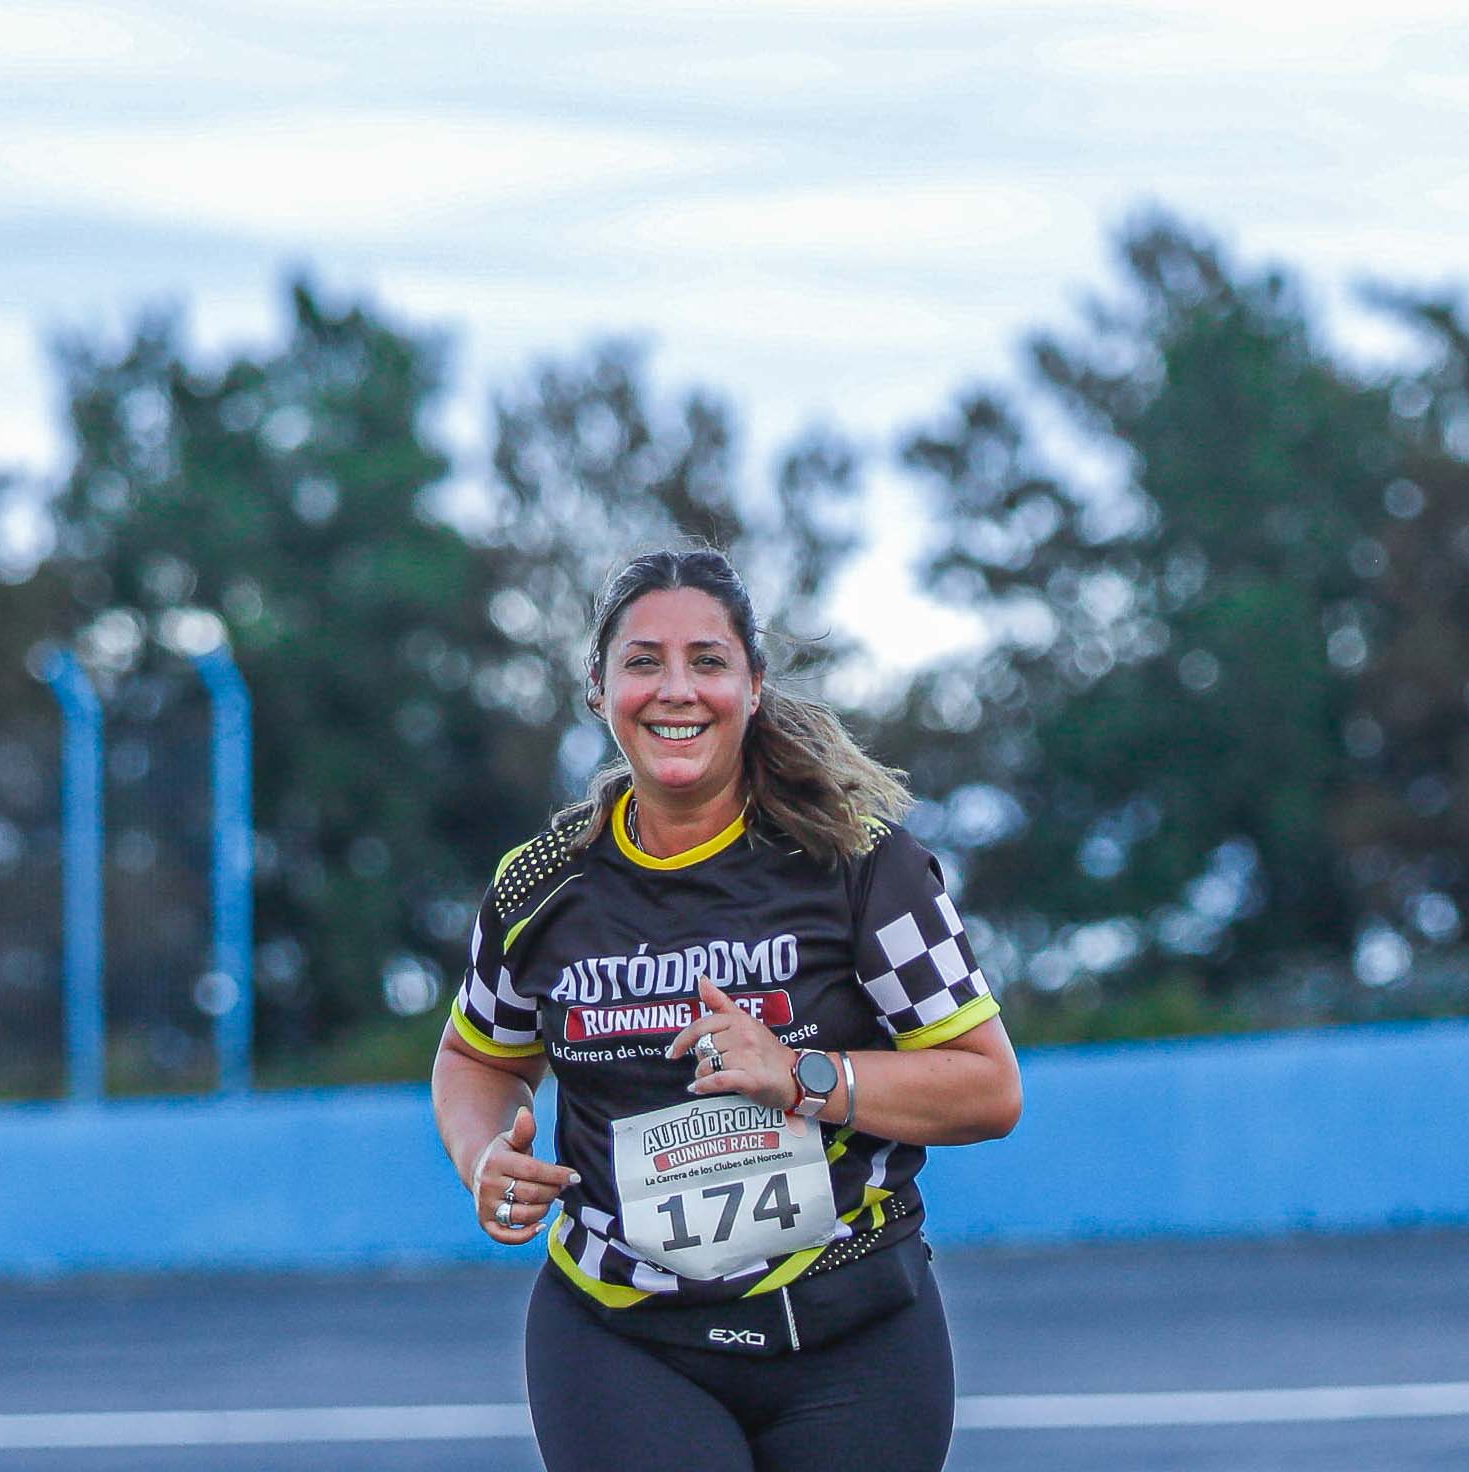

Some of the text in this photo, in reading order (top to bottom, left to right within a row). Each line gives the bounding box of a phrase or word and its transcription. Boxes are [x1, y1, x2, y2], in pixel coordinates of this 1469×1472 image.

[550, 934, 798, 1003] AUTÓDROMO
[581, 1003, 693, 1037] RUNNING
[563, 1046, 614, 1062] Carrera
[616, 1045, 637, 1059] de
[638, 1045, 662, 1056] los
[779, 1023, 819, 1046] oeste
[643, 1106, 787, 1155] AUTÓDROMO
[645, 1150, 794, 1186] La Carrera de los Clubes del Noroeste
[667, 1134, 766, 1167] RUNNING RACE
[657, 1173, 801, 1251] 174
[709, 1328, 766, 1346] EXO
